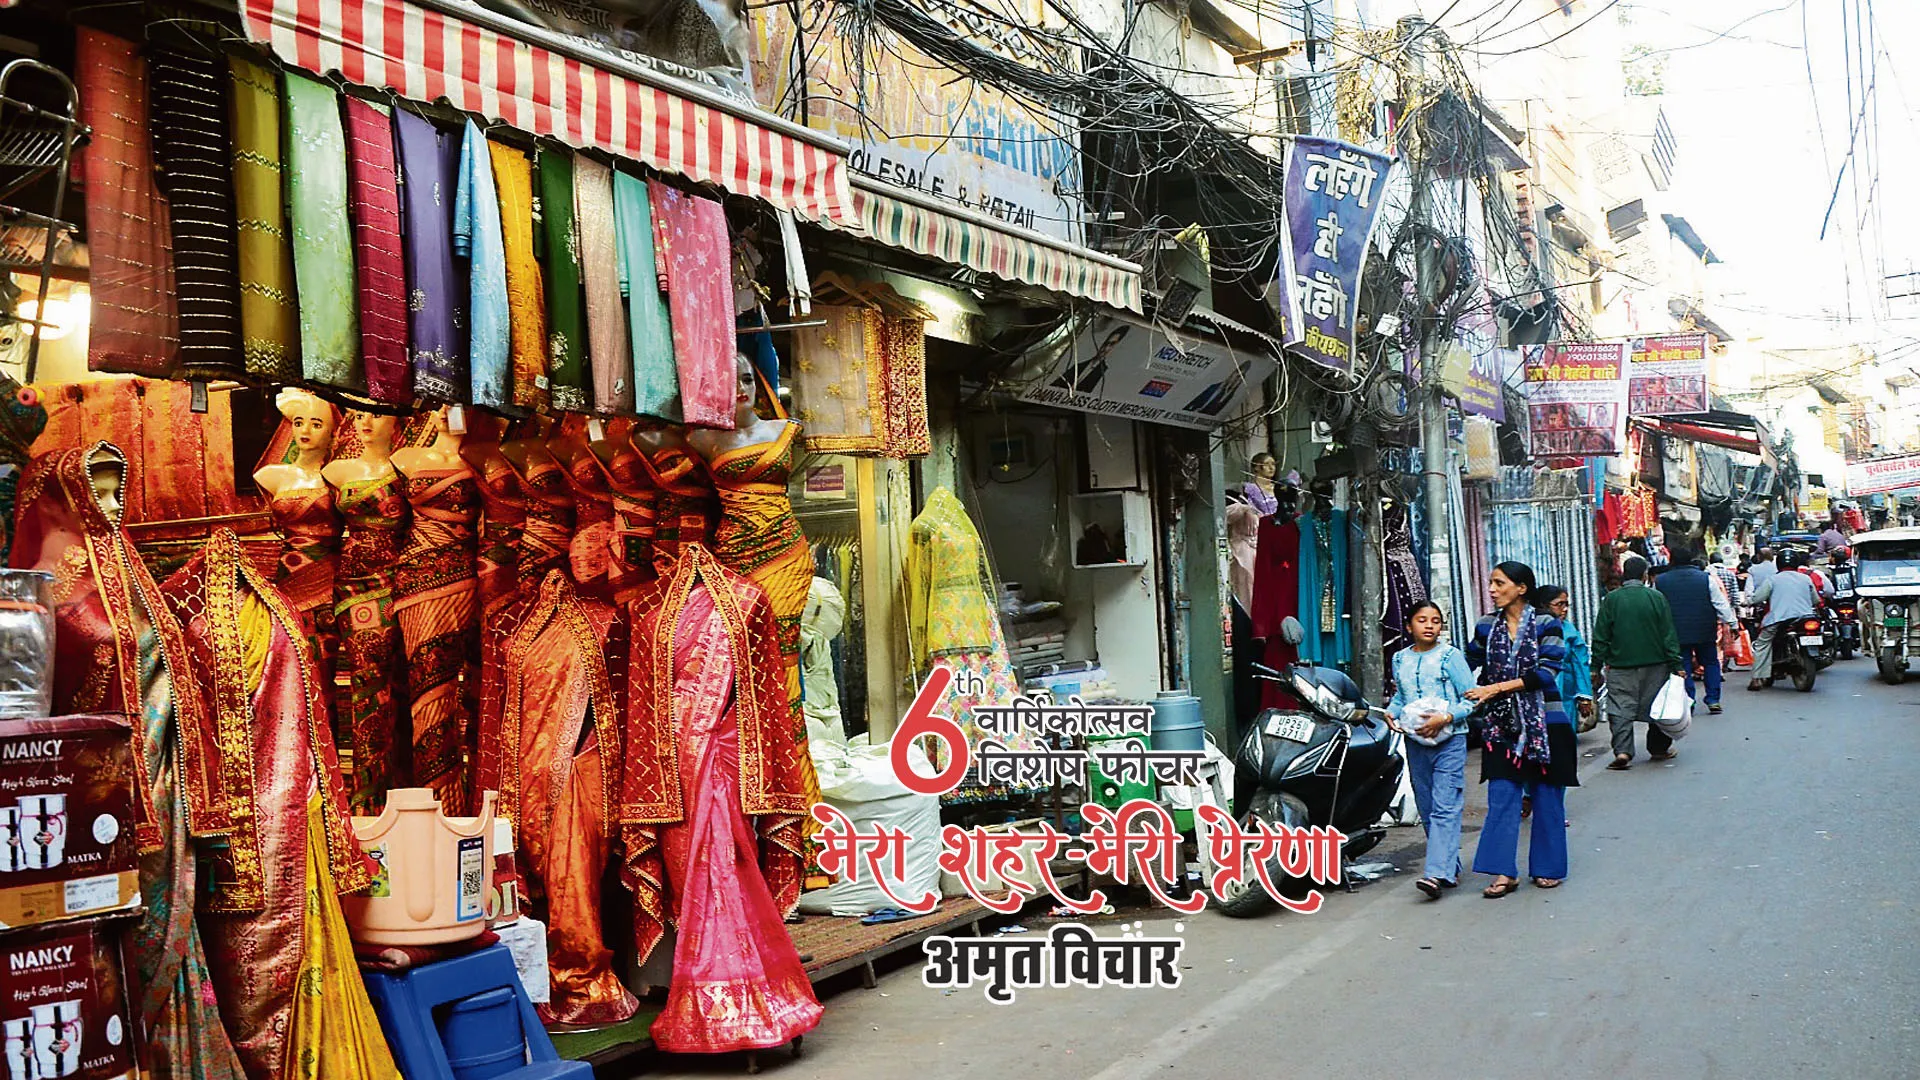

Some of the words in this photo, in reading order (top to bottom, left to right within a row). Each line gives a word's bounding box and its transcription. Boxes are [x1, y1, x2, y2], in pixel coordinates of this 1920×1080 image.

[979, 193, 1040, 232] RETAIL
[1314, 211, 1344, 264] ही
[1086, 397, 1119, 413] CLOTH
[1117, 403, 1166, 420] MERCHANT
[3, 740, 63, 759] NANCY
[67, 852, 102, 864] MATKA
[10, 945, 74, 970] NANCY
[82, 1054, 115, 1070] MATKA
